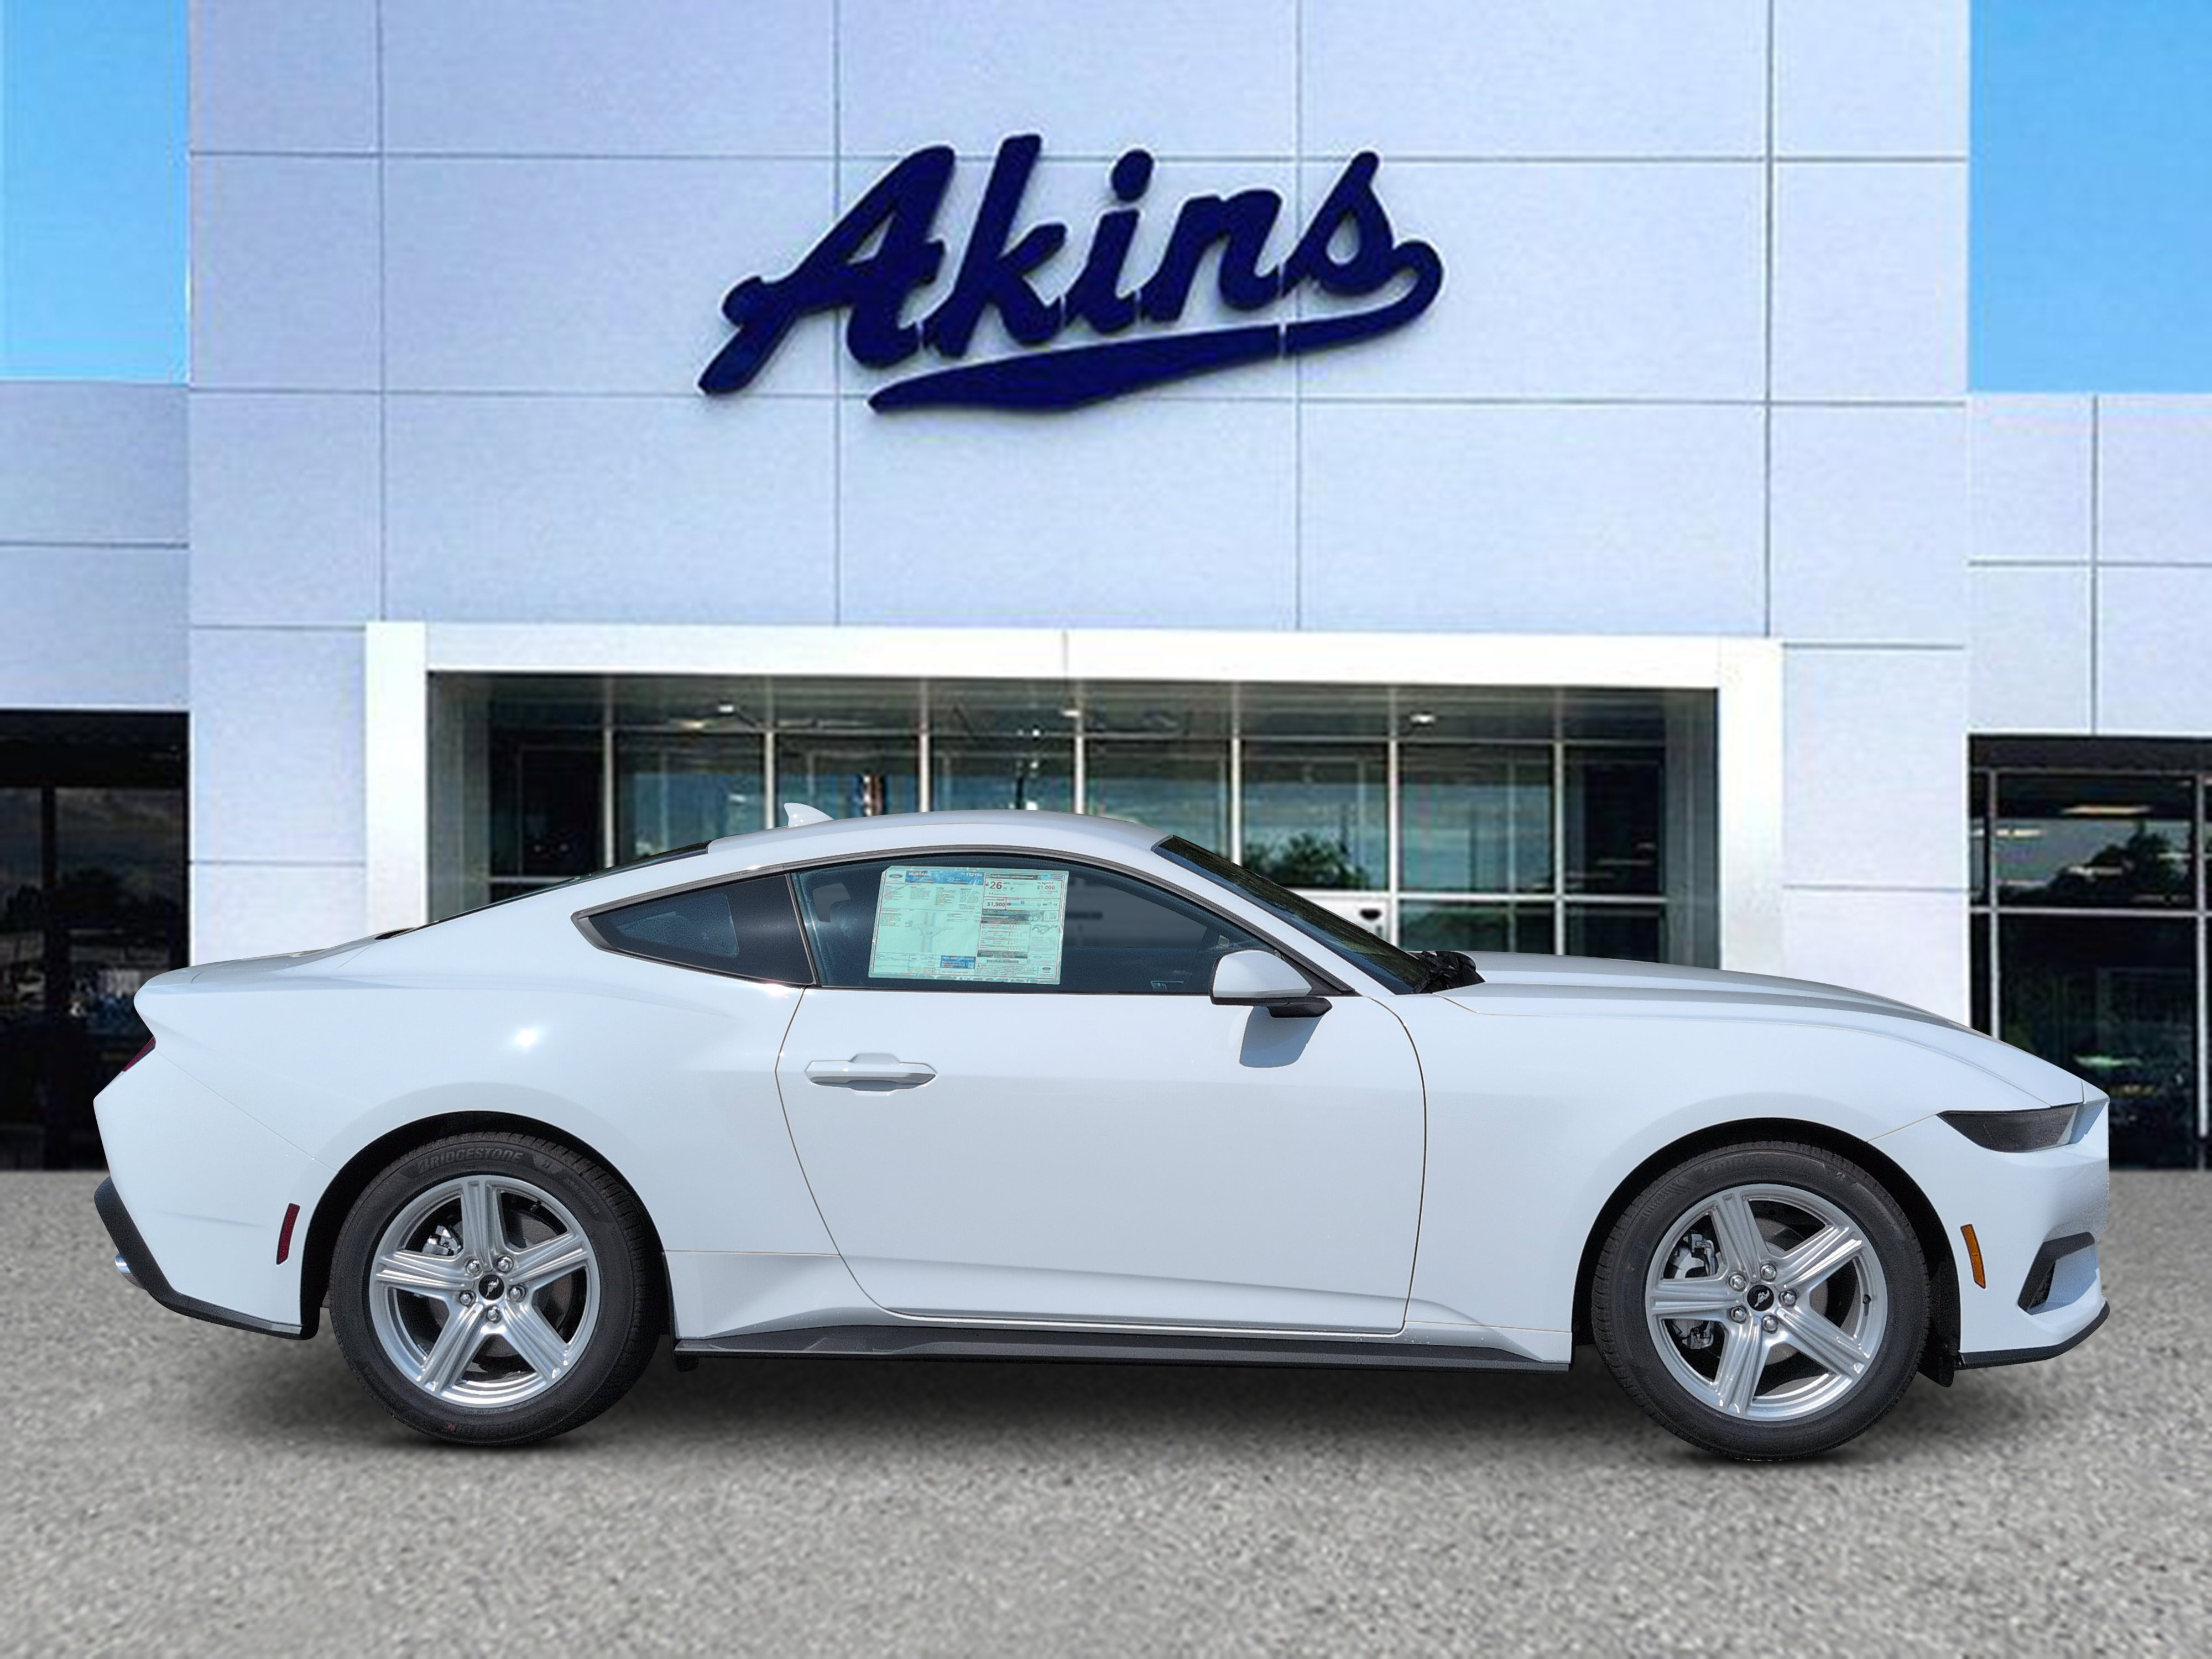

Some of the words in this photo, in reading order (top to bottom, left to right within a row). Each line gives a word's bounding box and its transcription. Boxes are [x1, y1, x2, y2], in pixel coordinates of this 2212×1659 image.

[698, 134, 1443, 414] Akins
[990, 881, 1002, 889] 26
[418, 1147, 524, 1173] BRIDGESTONE
